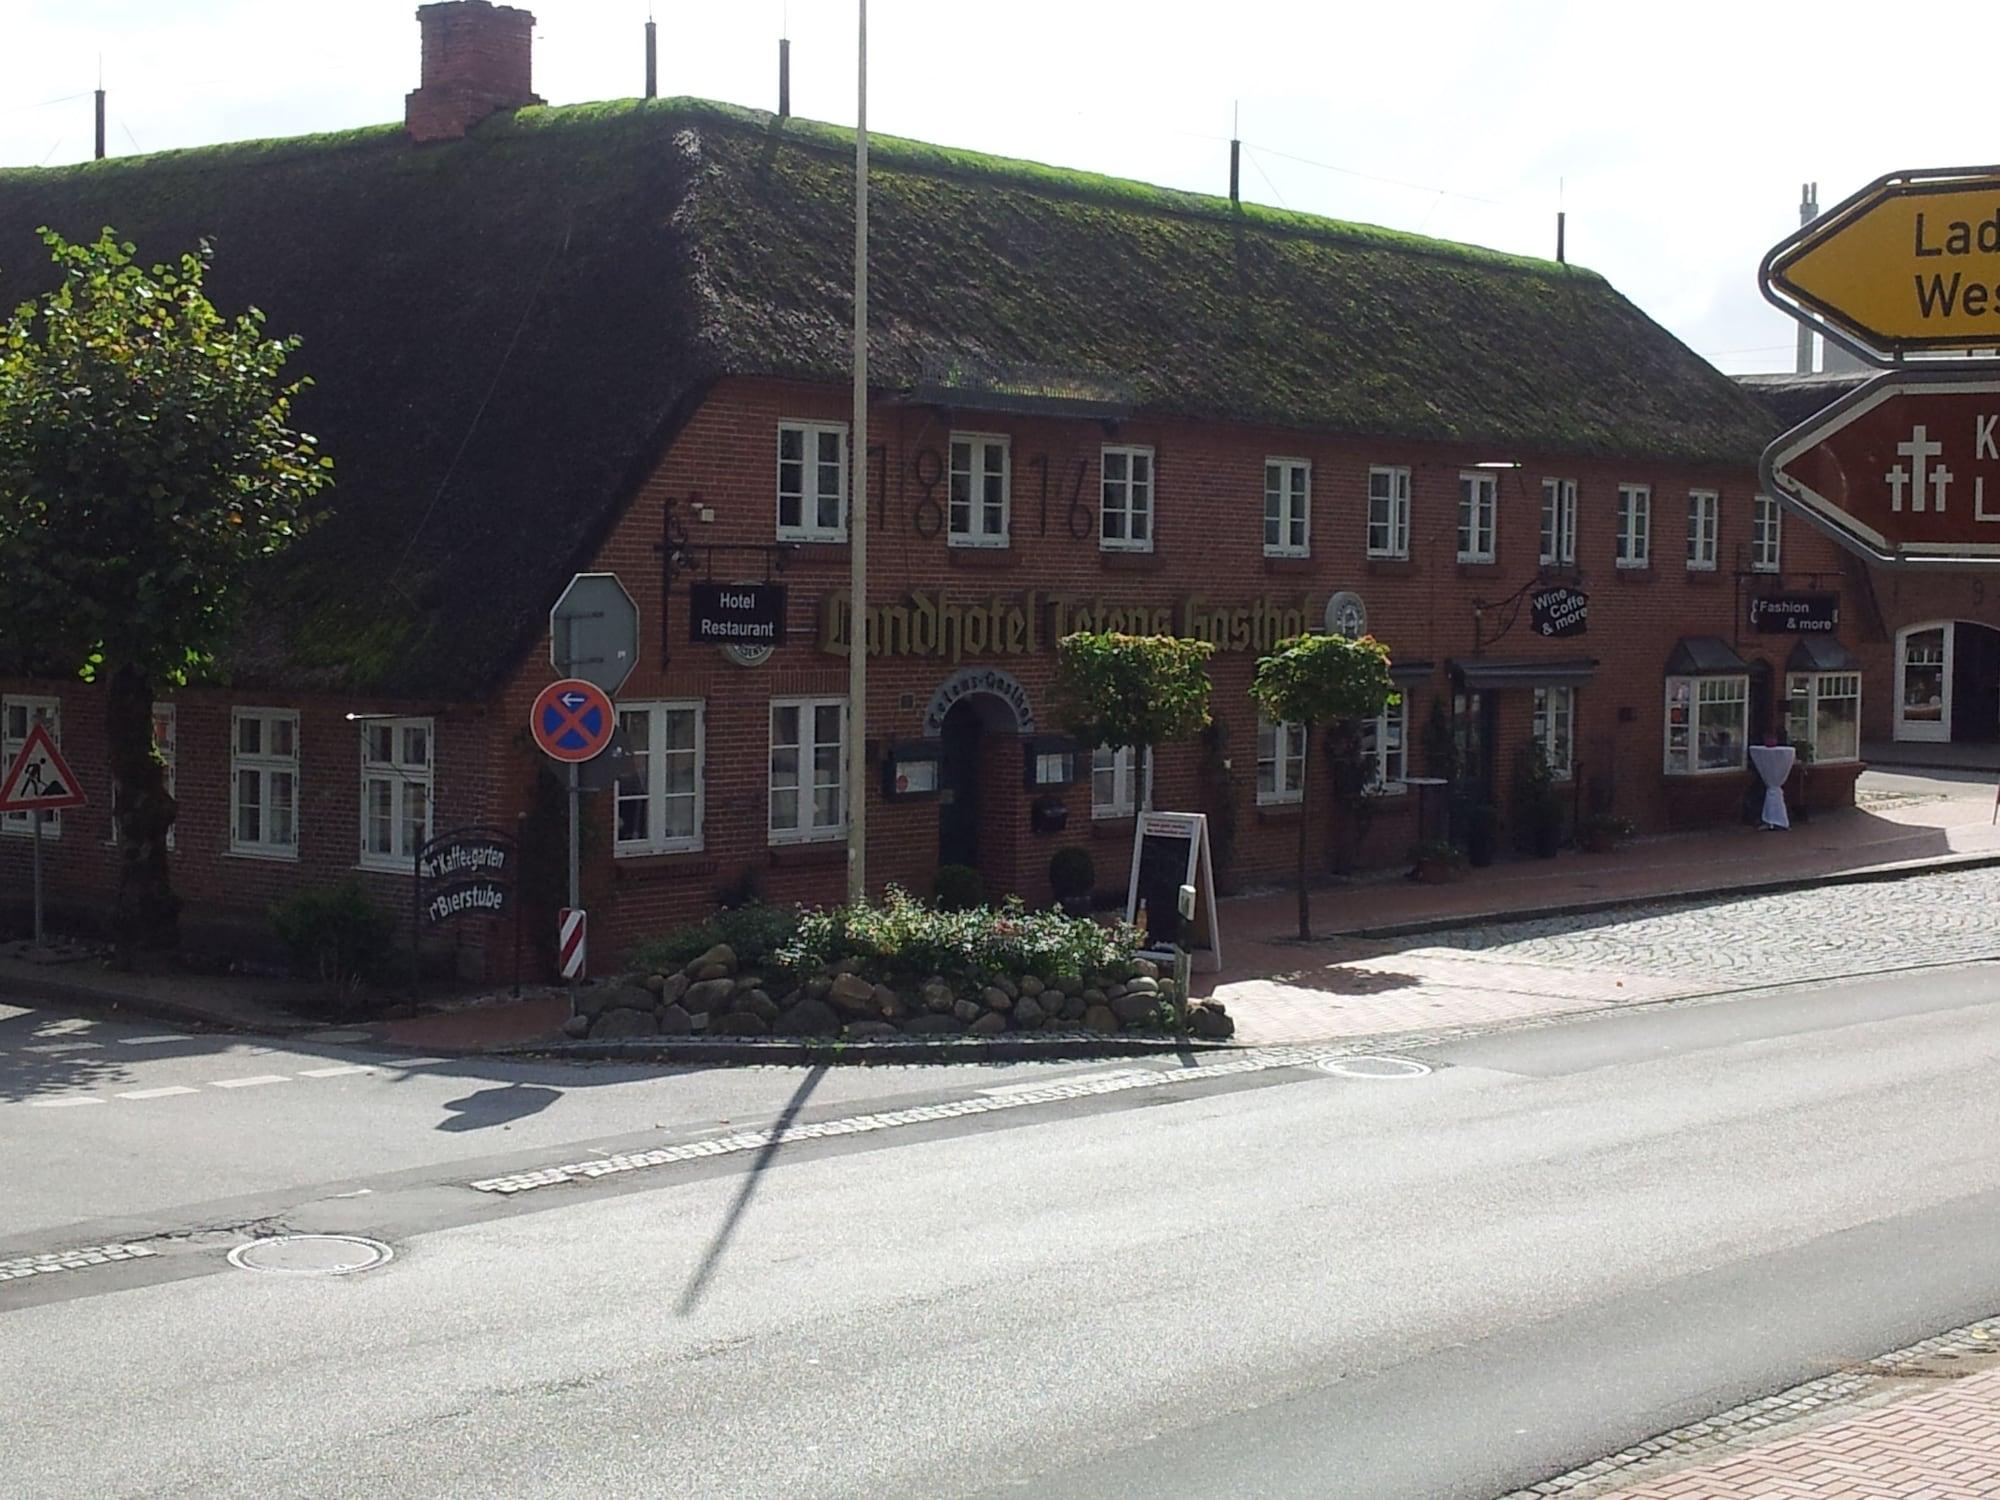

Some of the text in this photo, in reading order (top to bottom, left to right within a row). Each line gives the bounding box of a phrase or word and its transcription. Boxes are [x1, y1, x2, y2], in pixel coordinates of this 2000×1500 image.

[1915, 208, 2000, 257] Lad
[1914, 272, 2000, 318] We
[719, 592, 755, 609] Hotel
[1534, 588, 1568, 611] Wine
[1760, 600, 1810, 613] Fashion
[701, 618, 774, 637] Restaurant
[1542, 607, 1588, 636] & more
[1786, 617, 1832, 630] & more
[436, 883, 503, 917] Bierstube
